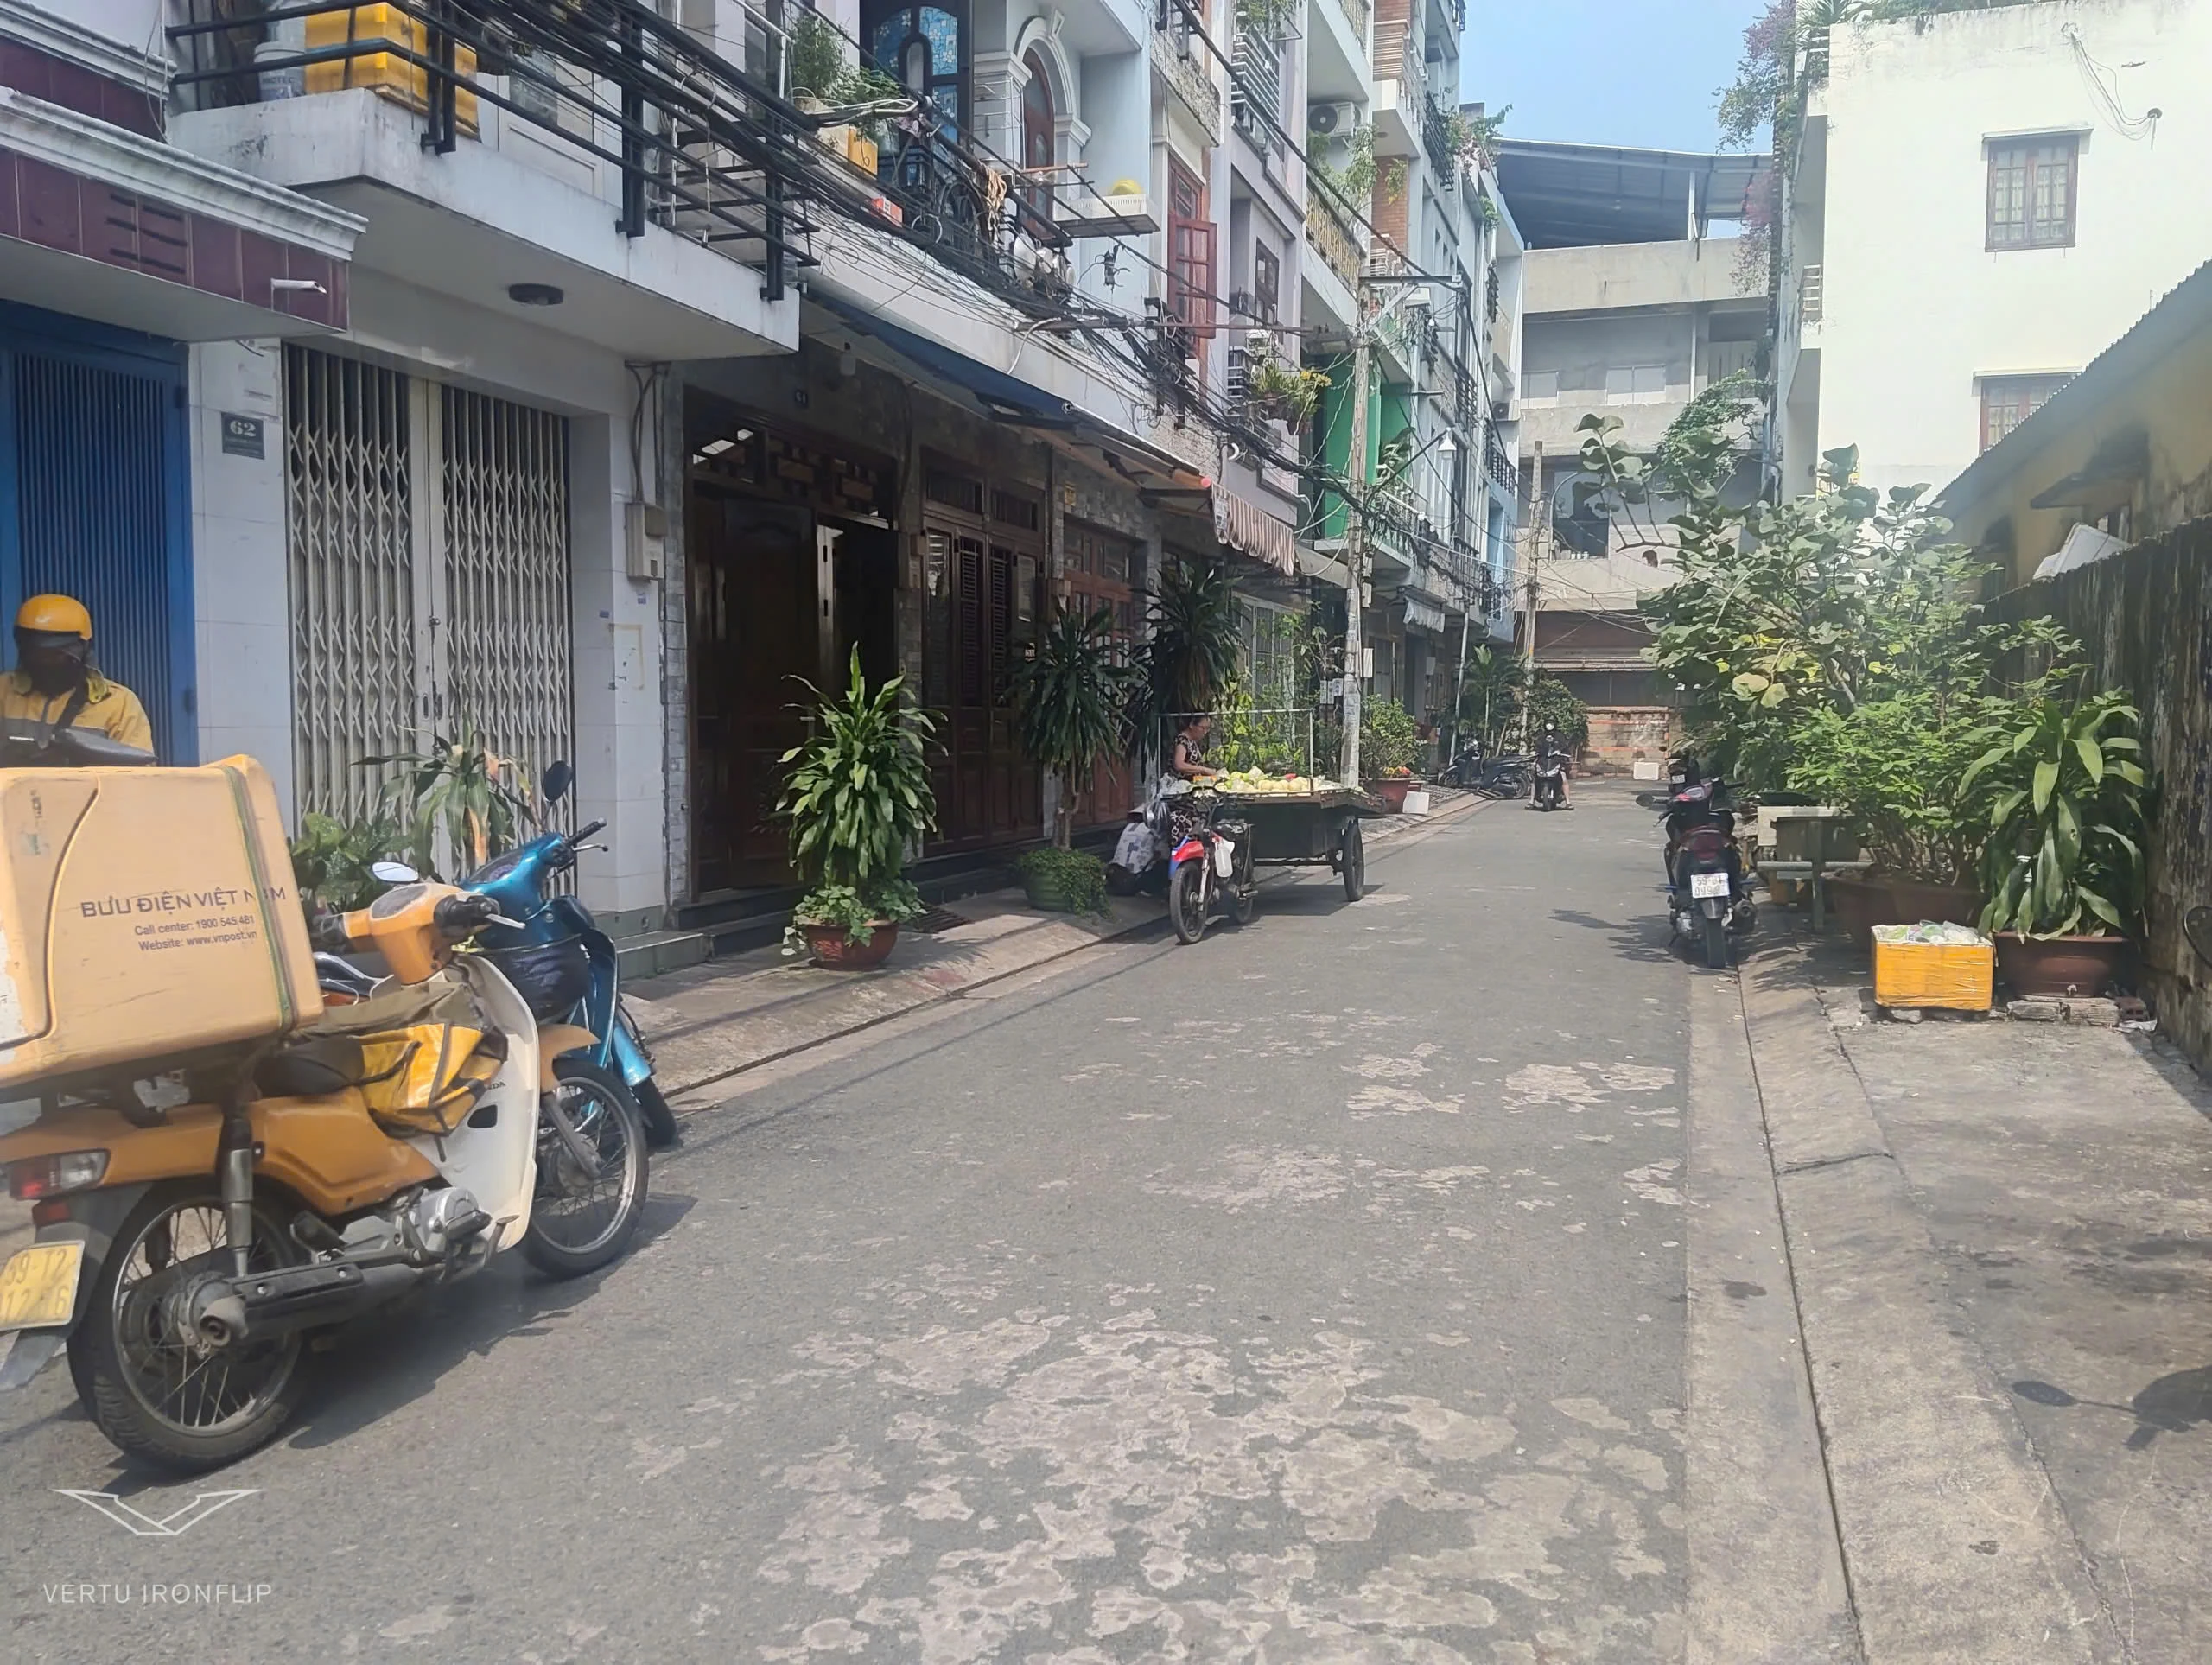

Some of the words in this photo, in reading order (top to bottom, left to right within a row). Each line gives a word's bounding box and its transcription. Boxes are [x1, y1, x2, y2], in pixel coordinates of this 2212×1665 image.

[230, 420, 257, 437] 62
[80, 895, 132, 918] BƯU
[136, 891, 192, 915] ĐIỆN
[194, 887, 238, 911] VIỆT
[243, 887, 287, 903] NM
[134, 924, 156, 937] Call
[158, 921, 194, 934] center:
[196, 918, 219, 930] 1900
[220, 916, 237, 927] 545
[238, 914, 255, 925] 481
[138, 937, 184, 951] Website:
[187, 931, 257, 946] www.vnpost.vn
